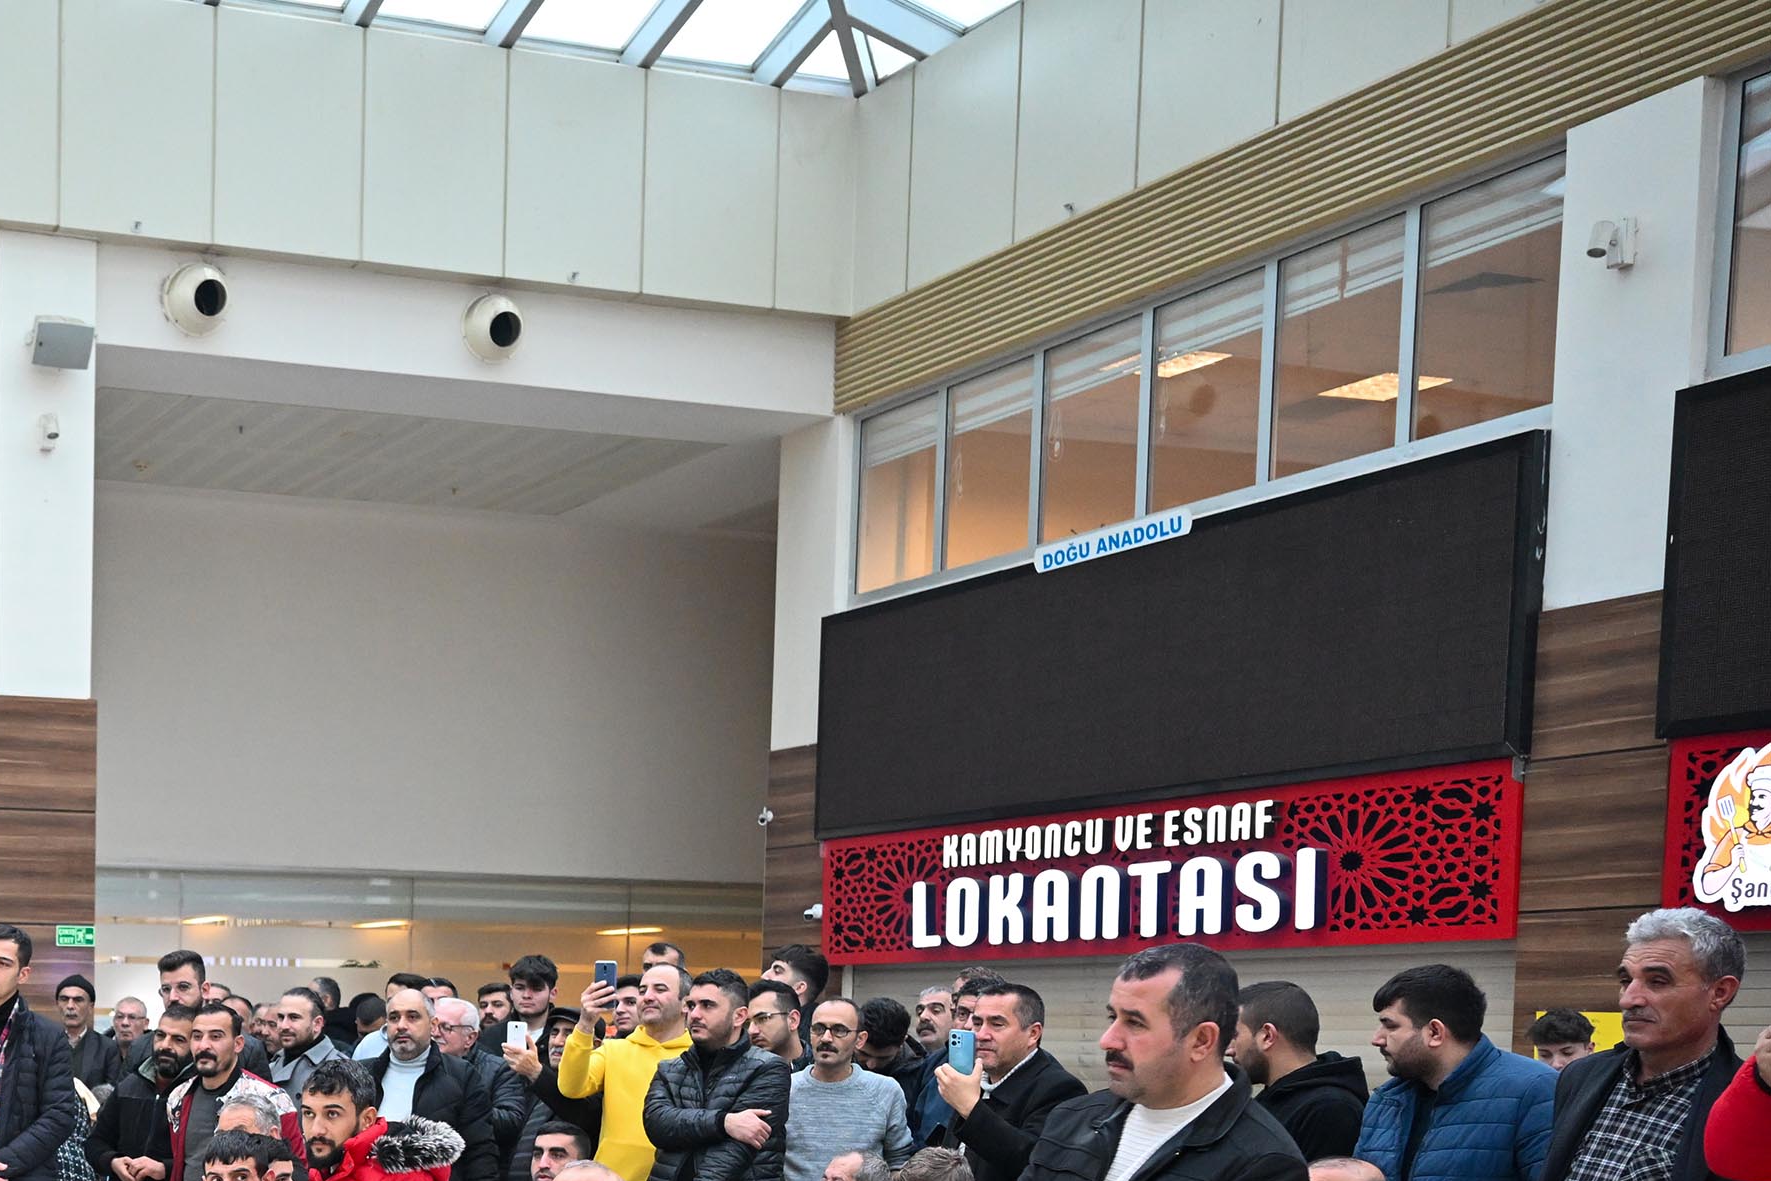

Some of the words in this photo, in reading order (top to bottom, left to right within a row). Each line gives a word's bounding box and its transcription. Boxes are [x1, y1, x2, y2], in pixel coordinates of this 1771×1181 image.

[1043, 542, 1090, 569] DOĞU
[1096, 515, 1182, 554] ANADOLU
[942, 817, 1104, 868] KAMYONCU
[1114, 813, 1153, 852] VE
[1164, 799, 1274, 847] ESNAF
[912, 846, 1316, 948] LOKANTASI
[1731, 877, 1771, 904] Şan
